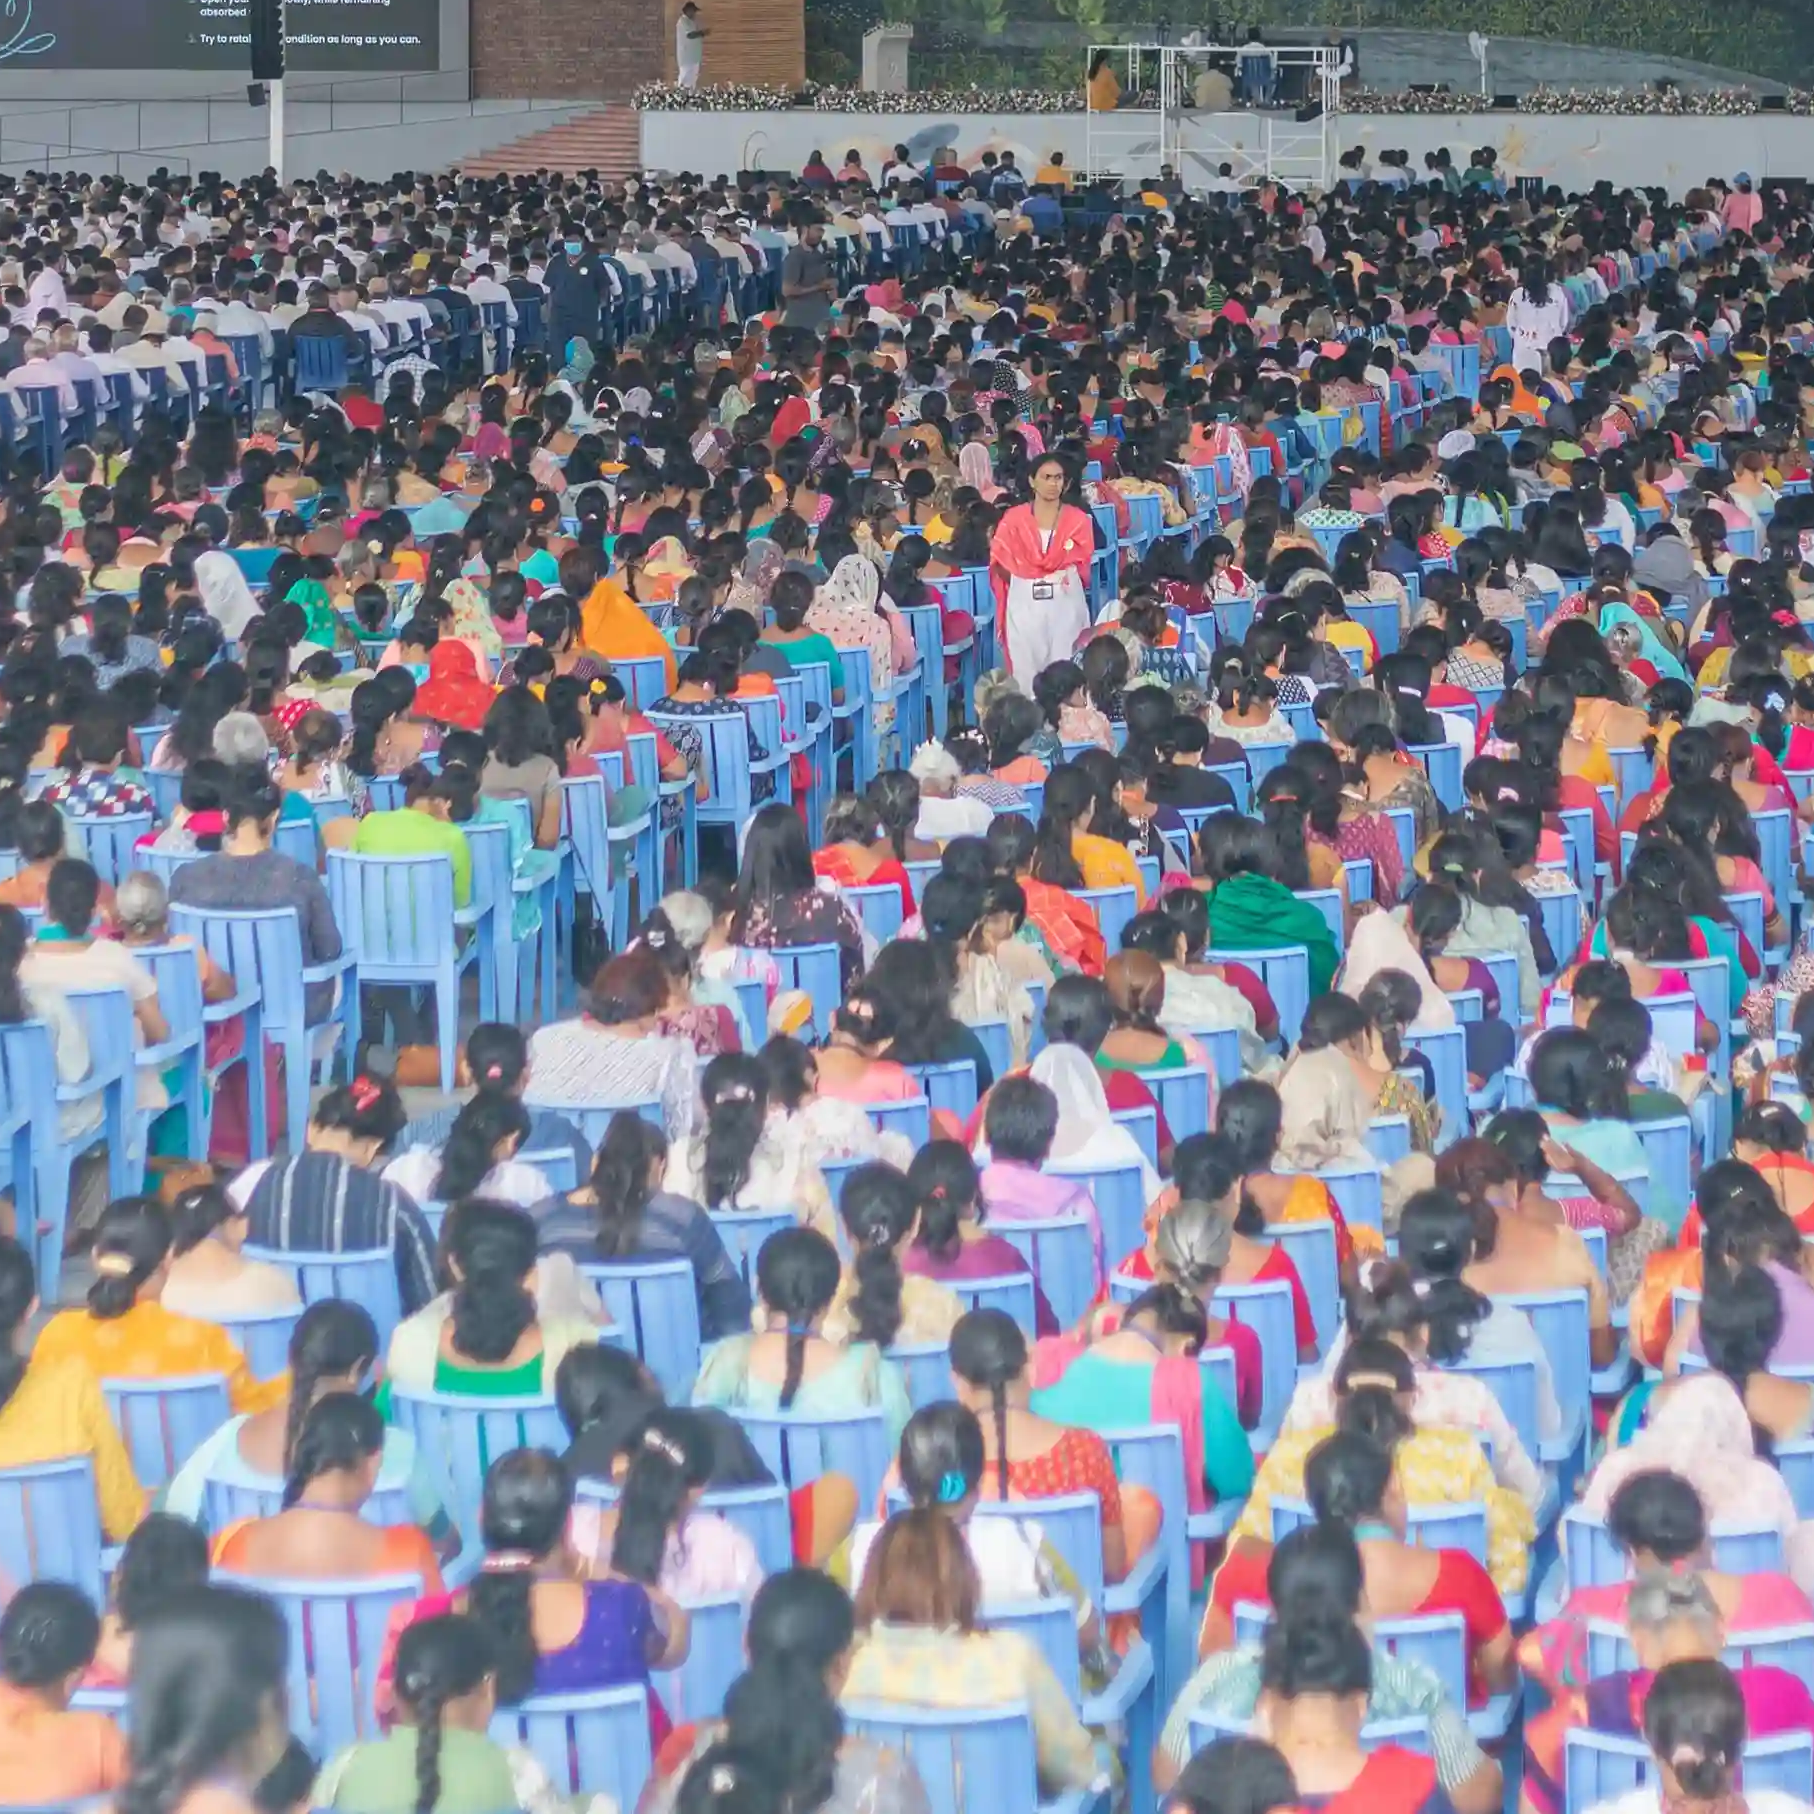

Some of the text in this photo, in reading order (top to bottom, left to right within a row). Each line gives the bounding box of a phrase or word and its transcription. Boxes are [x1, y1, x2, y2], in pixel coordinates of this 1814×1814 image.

[200, 7, 247, 17] absorbed
[200, 34, 215, 46] Try
[217, 34, 227, 43] to
[229, 34, 252, 43] retai
[285, 34, 325, 43] ondition
[341, 34, 363, 46] long
[379, 36, 397, 46] you
